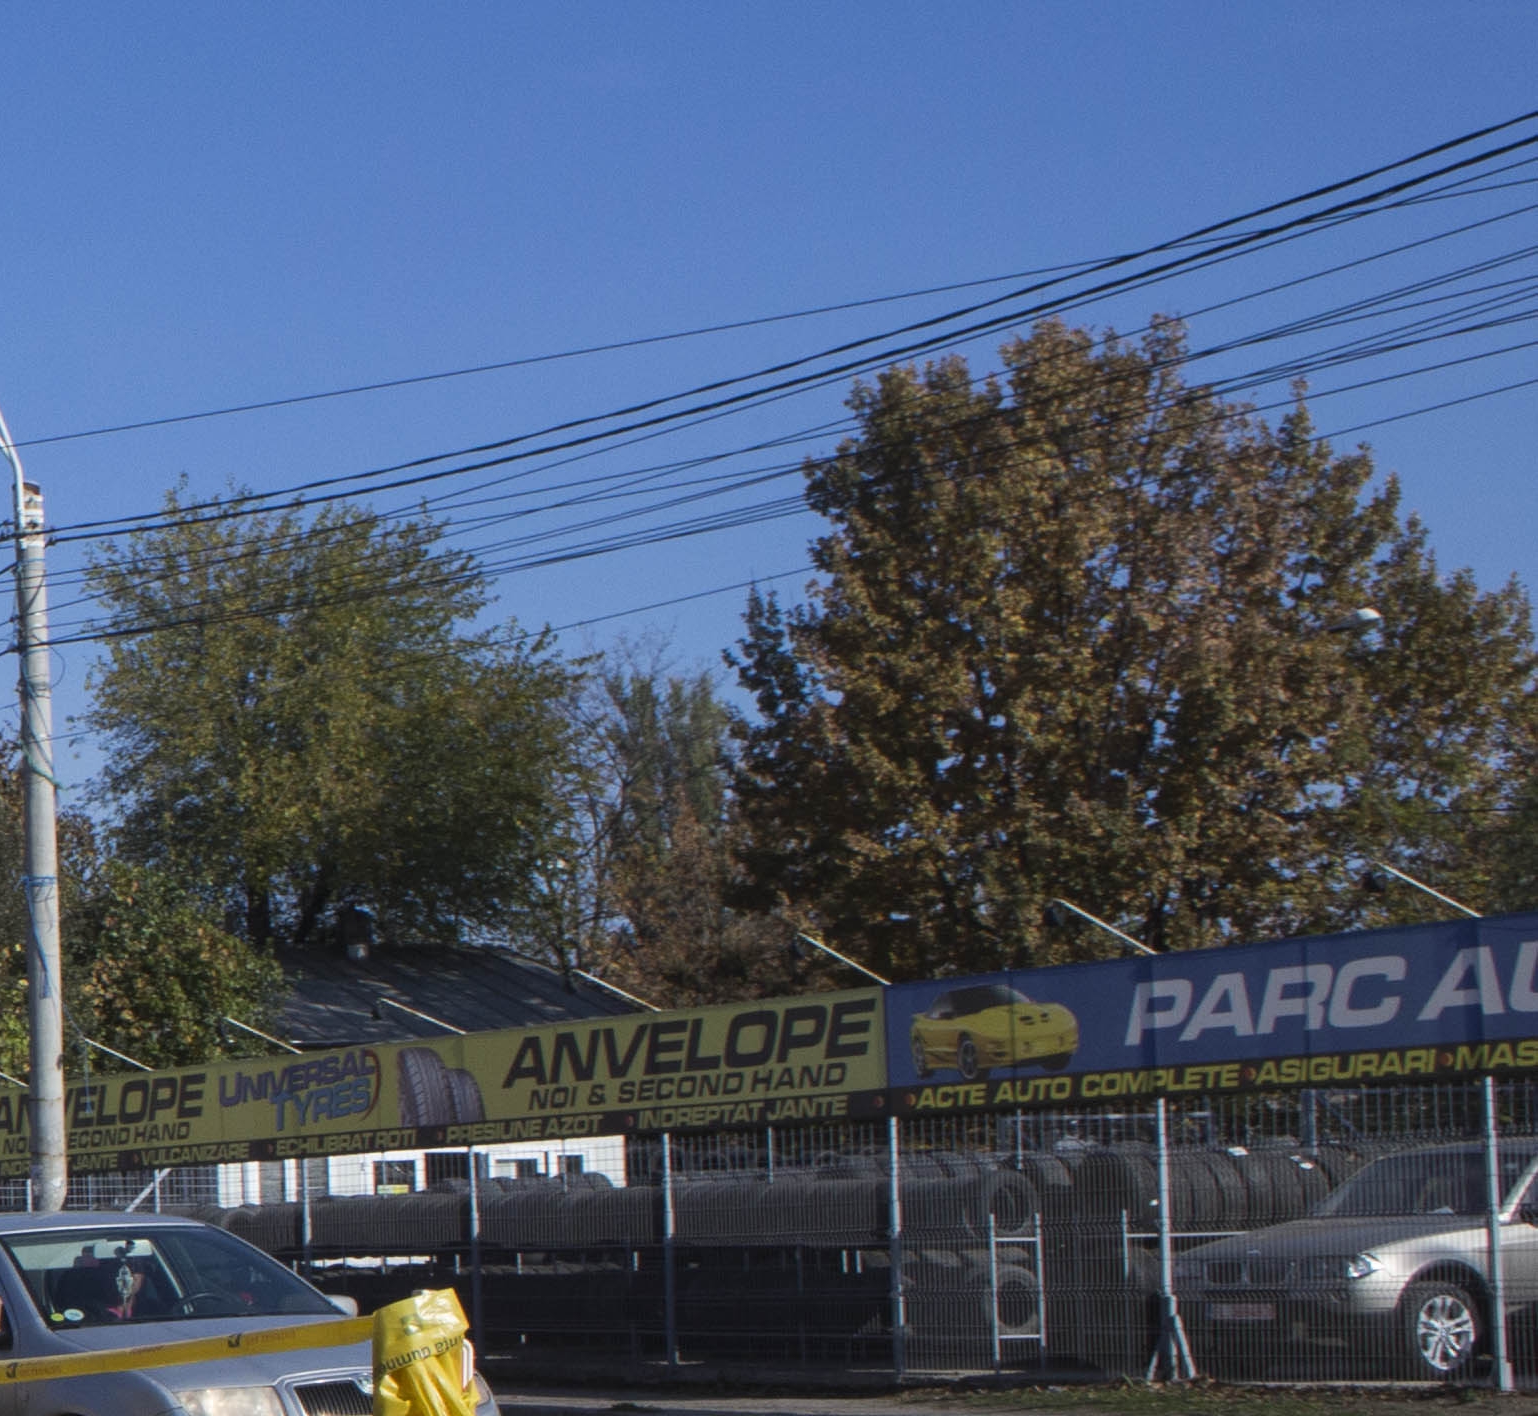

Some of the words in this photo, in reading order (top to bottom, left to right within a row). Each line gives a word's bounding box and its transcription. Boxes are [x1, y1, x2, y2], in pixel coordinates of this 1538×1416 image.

[1125, 956, 1408, 1046] PARC
[502, 998, 878, 1089] ANVELOPE
[528, 1086, 578, 1111] NOI
[588, 1084, 607, 1106] &
[618, 1073, 744, 1102] SECOND
[751, 1063, 847, 1092] HAND
[915, 1083, 988, 1110] ACTE
[993, 1076, 1072, 1104] AUTO
[1081, 1064, 1242, 1097] COMPLETE
[1255, 1049, 1437, 1085] ASIGURARI
[67, 1127, 130, 1149] ECOND
[133, 1121, 191, 1145] HAND
[445, 1118, 541, 1143] PRESIUNE
[544, 1113, 604, 1135] AZOT
[638, 1101, 764, 1130] INDREPTAT
[766, 1095, 849, 1120] JANTE
[141, 1142, 250, 1166] VULCANIZARE
[275, 1132, 373, 1156] ECHILIBRAT
